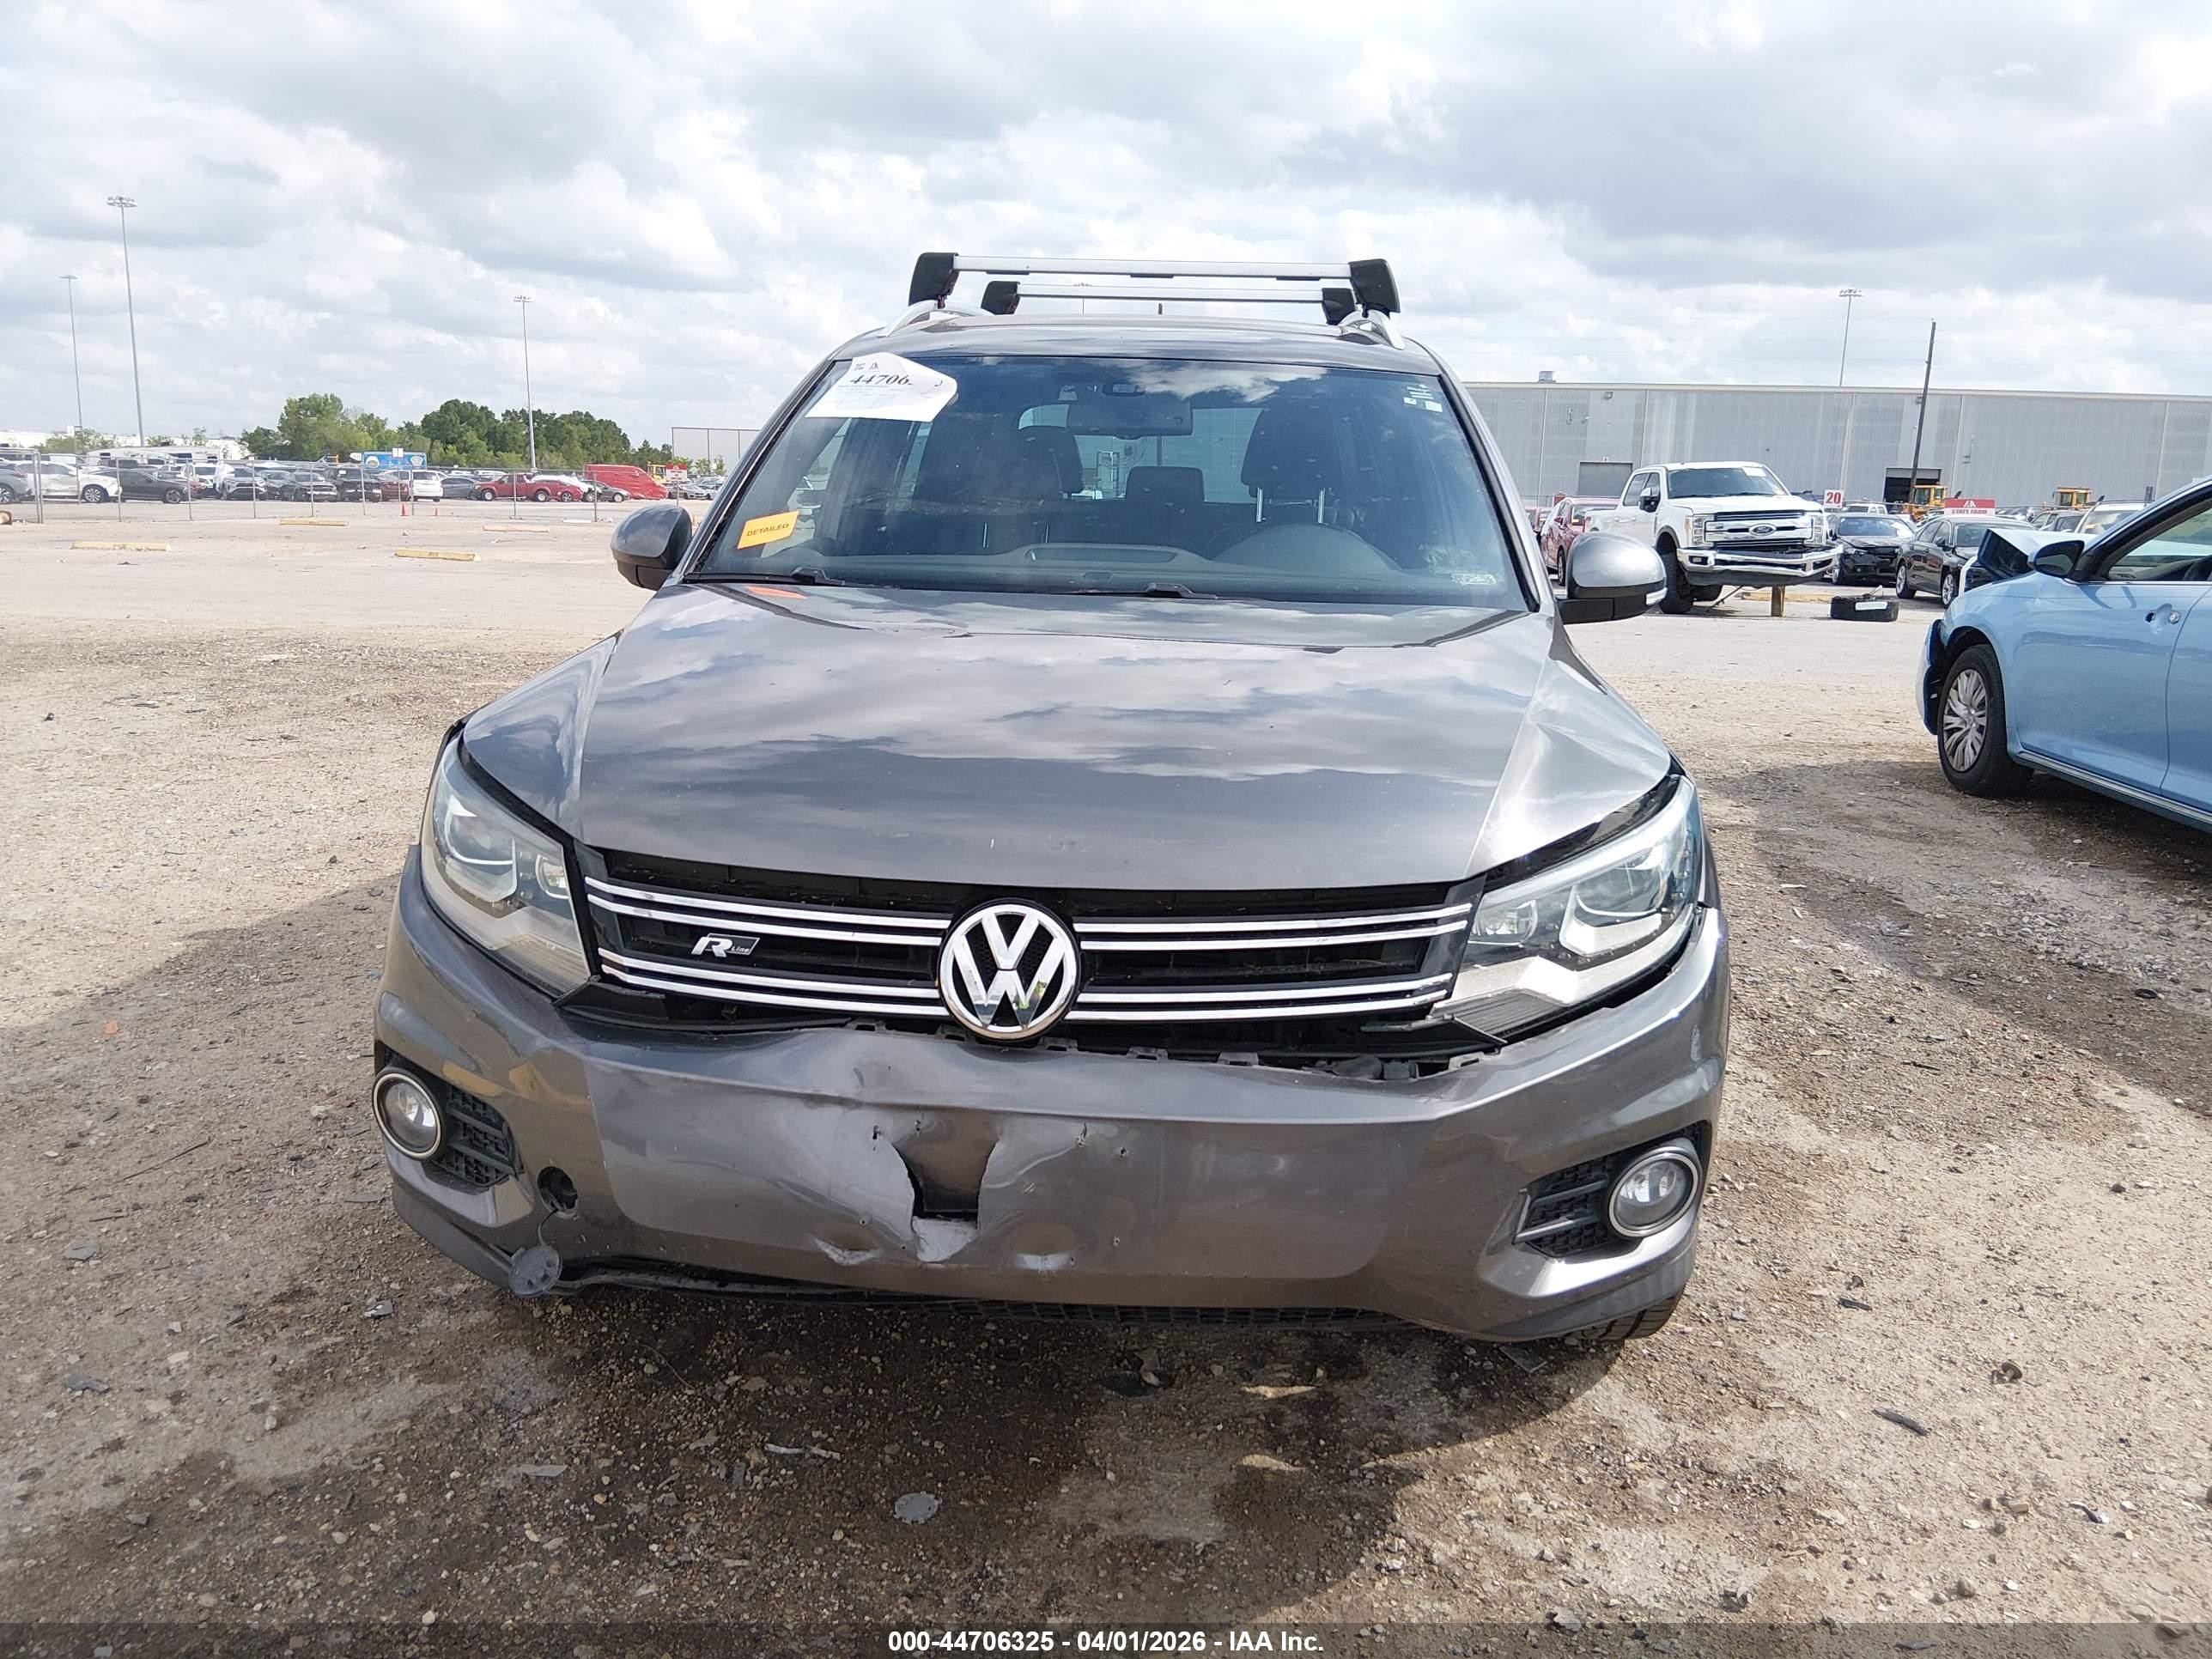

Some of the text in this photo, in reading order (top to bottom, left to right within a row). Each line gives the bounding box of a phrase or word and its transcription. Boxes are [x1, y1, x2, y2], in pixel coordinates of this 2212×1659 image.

[850, 374, 914, 386] 44706
[1826, 492, 1842, 504] 20
[746, 523, 789, 537] DETAILED
[690, 936, 732, 957] R
[946, 908, 1070, 1036] VW
